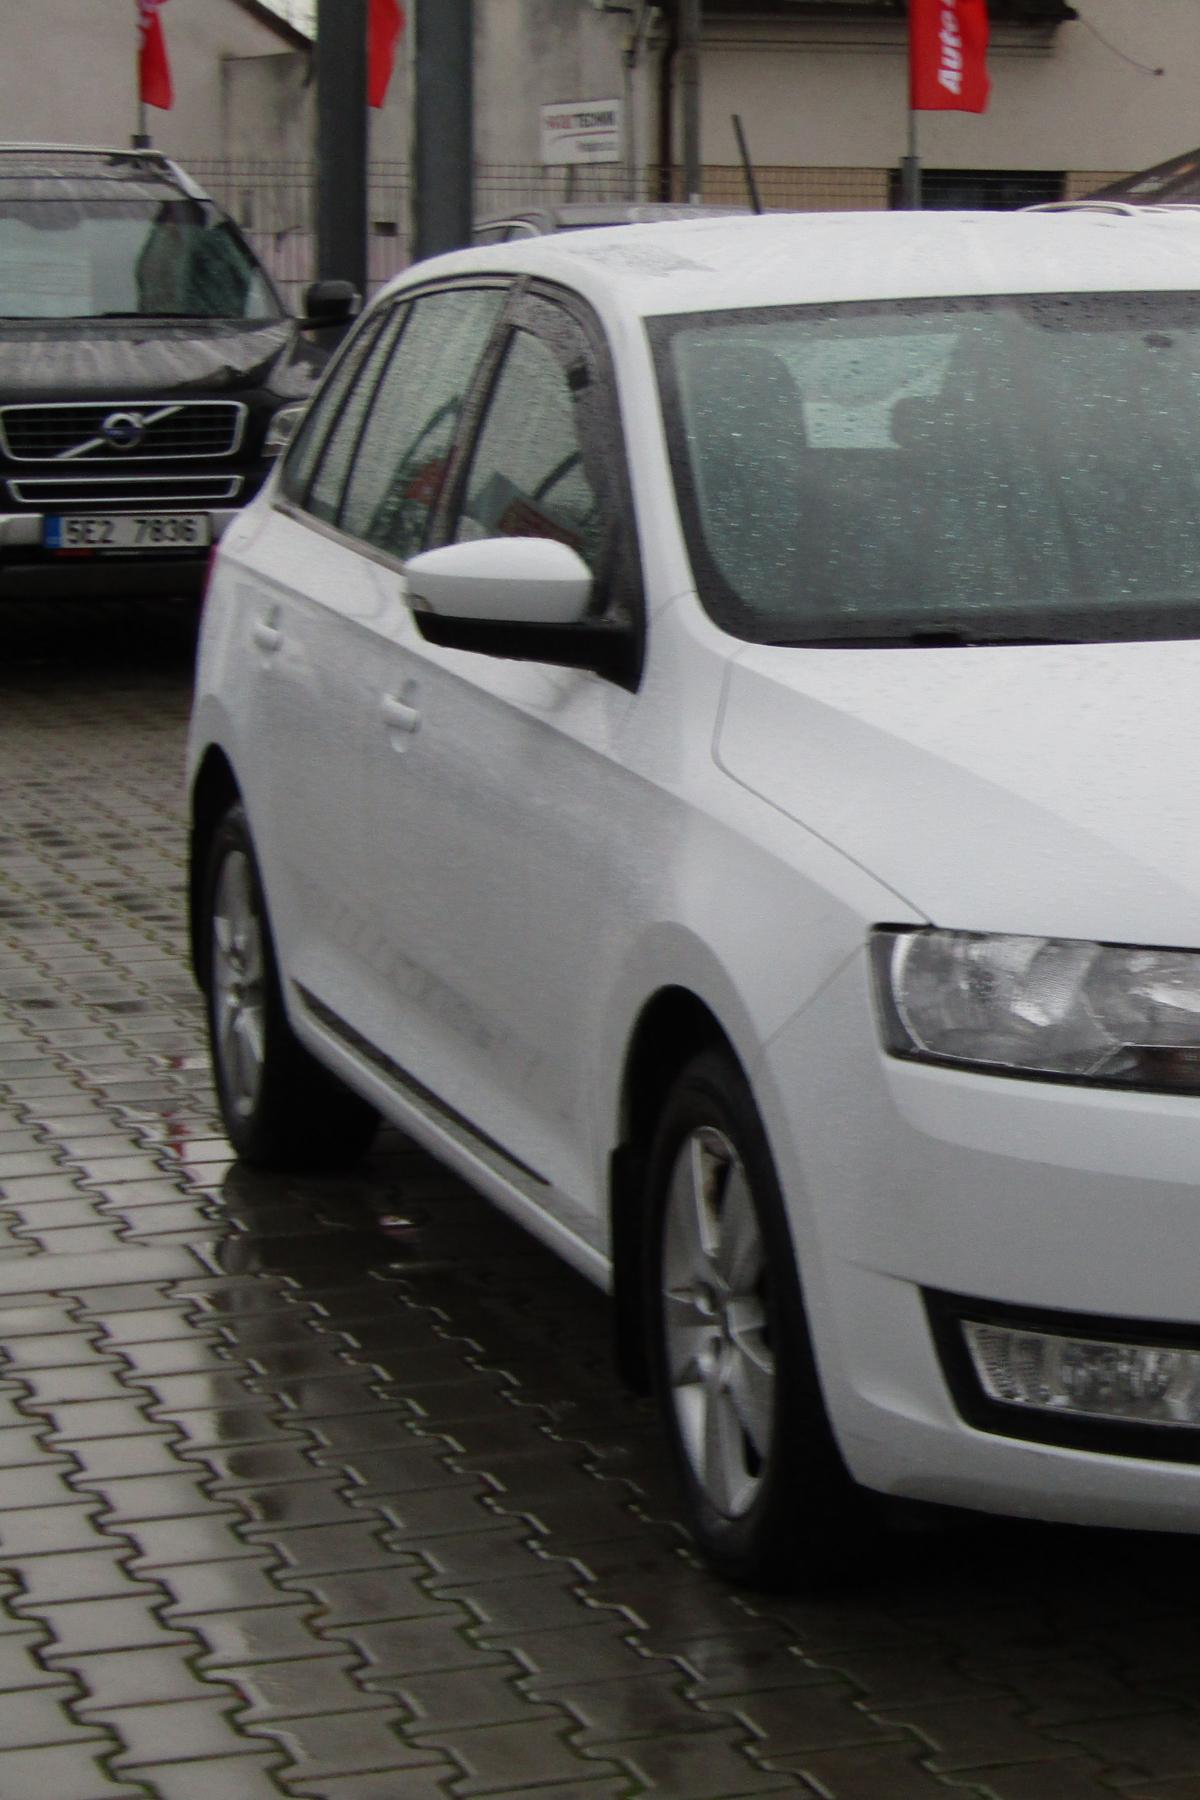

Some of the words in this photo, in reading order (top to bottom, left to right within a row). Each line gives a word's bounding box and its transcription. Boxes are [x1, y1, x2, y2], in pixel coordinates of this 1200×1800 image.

[938, 10, 964, 95] Auto
[66, 518, 116, 545] 5E2
[133, 517, 198, 544] 7836
